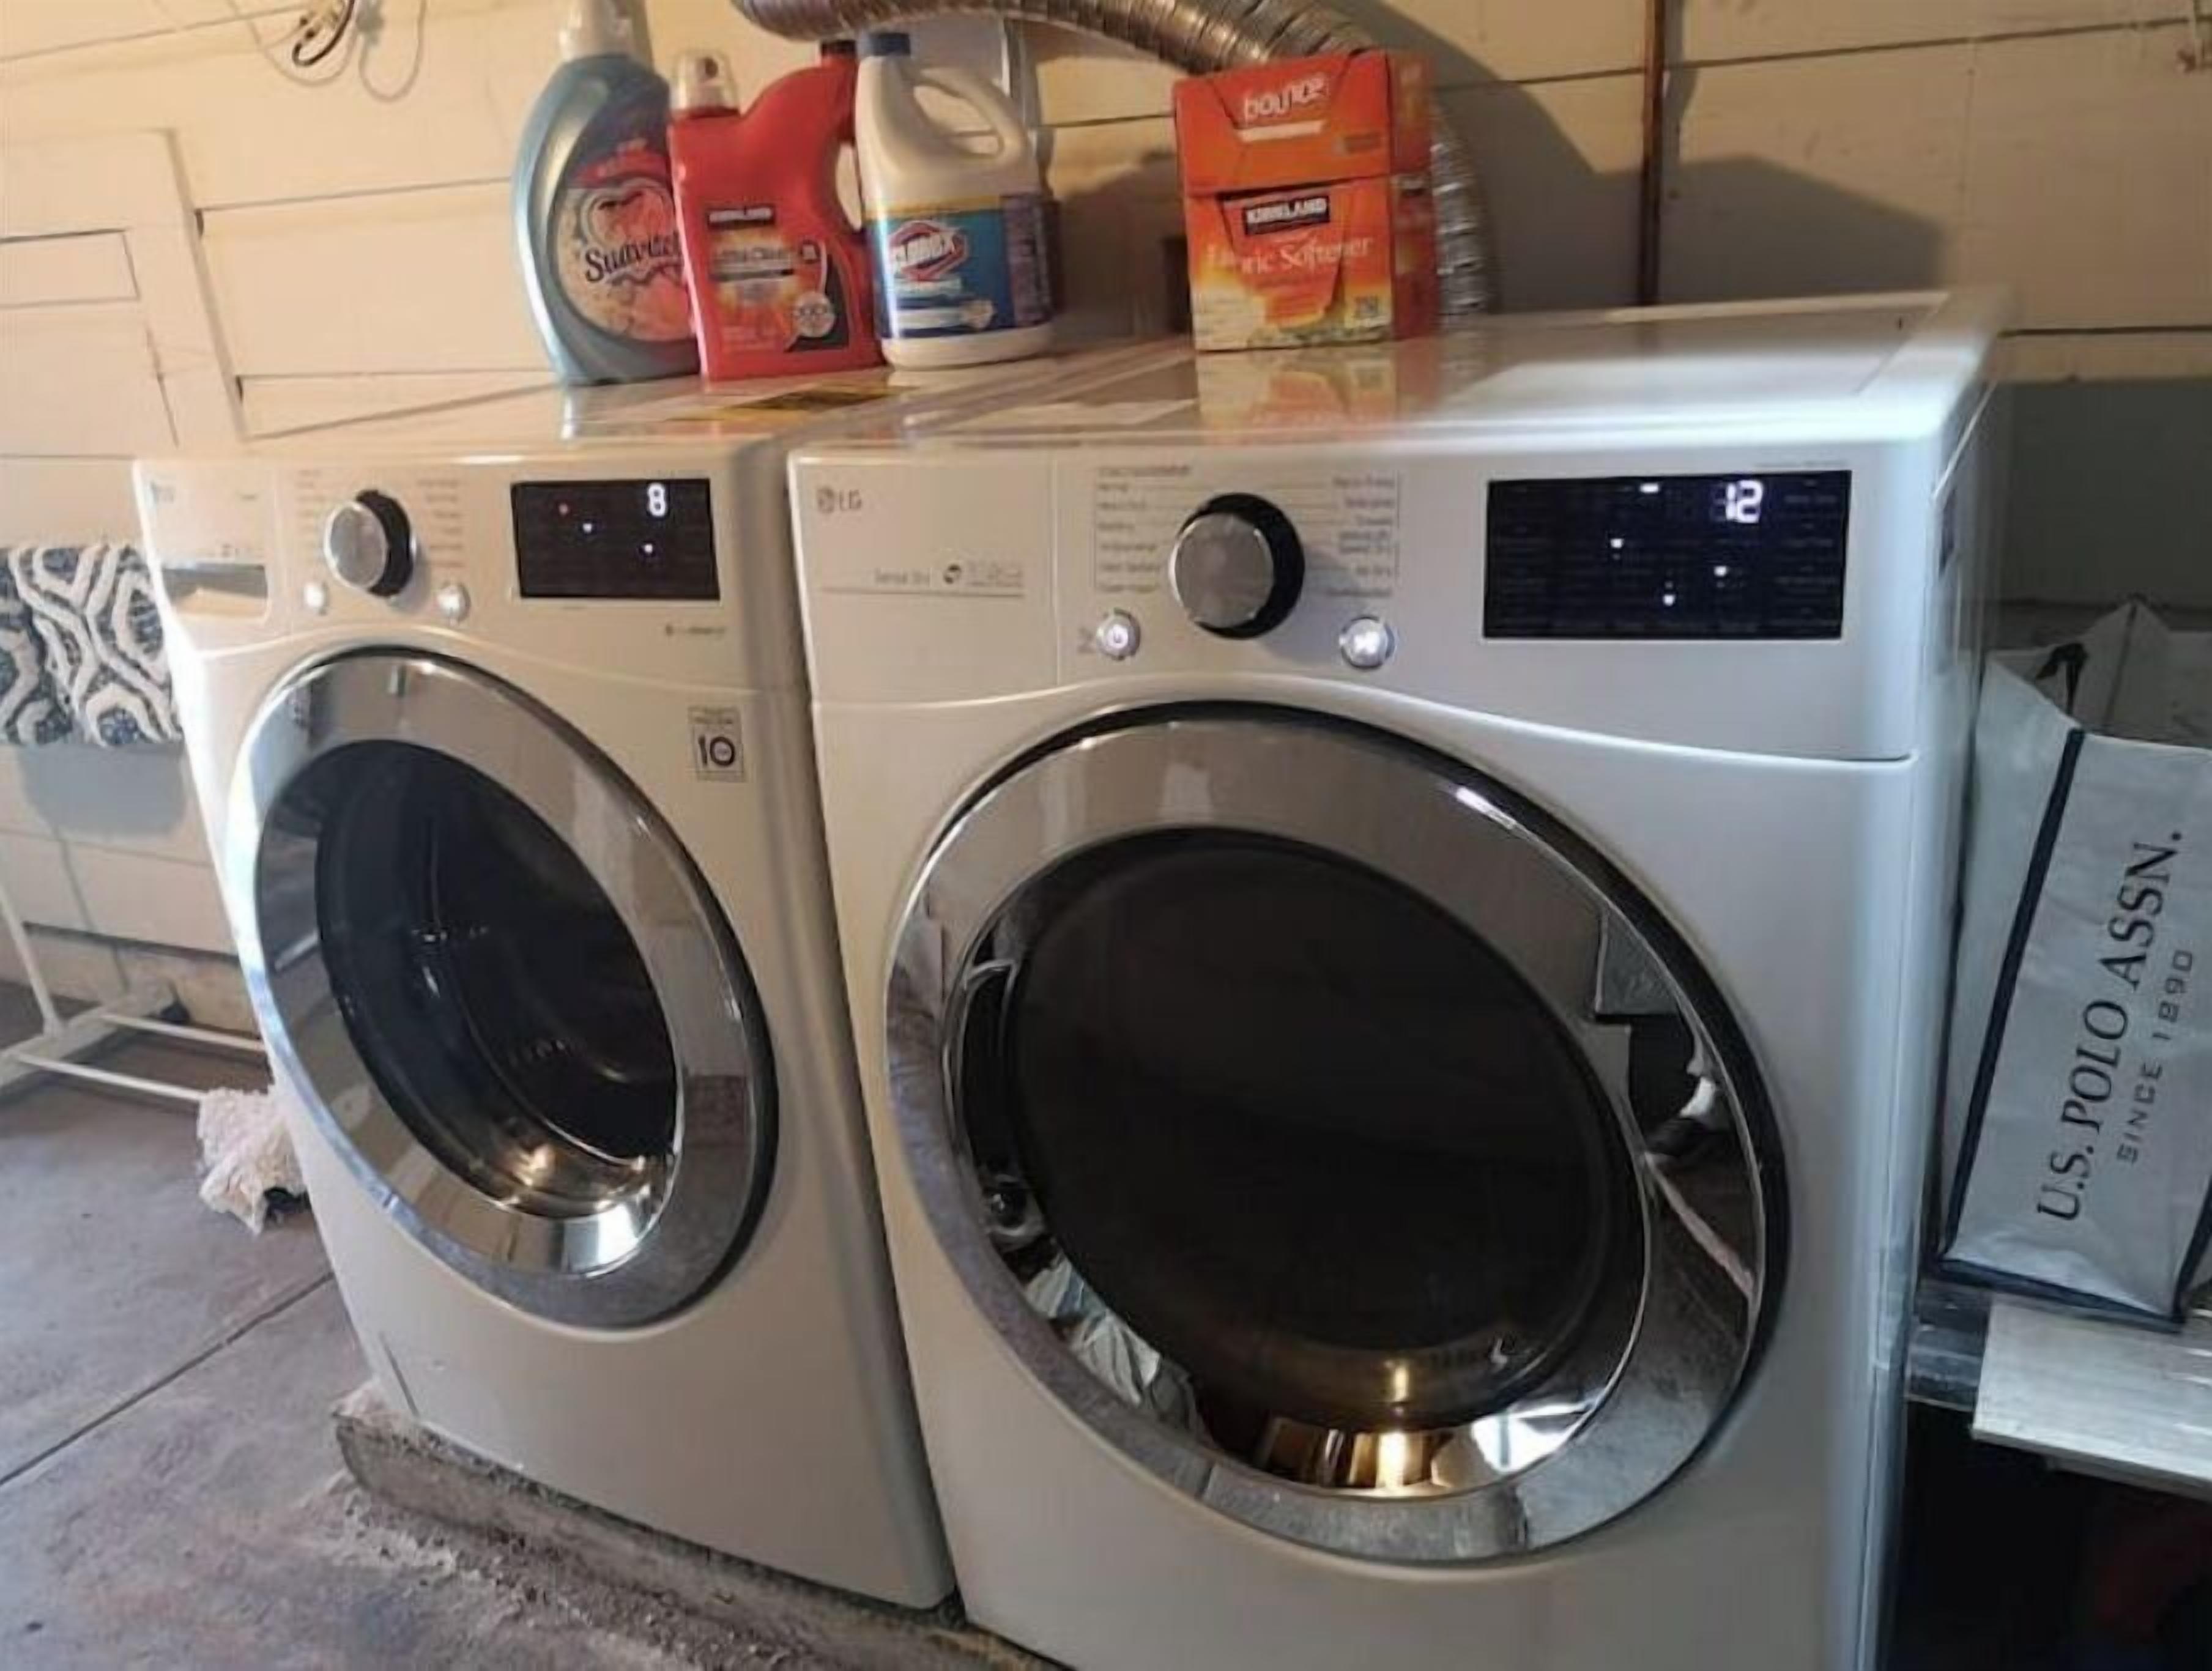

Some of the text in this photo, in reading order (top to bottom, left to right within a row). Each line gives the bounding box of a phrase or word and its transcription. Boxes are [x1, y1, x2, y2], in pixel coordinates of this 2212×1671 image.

[647, 483, 667, 517] 8
[1726, 480, 1764, 524] 12
[2036, 832, 2182, 1220] U.S. POLO ASSN.
[2117, 949, 2194, 1163] SINCE 1890
